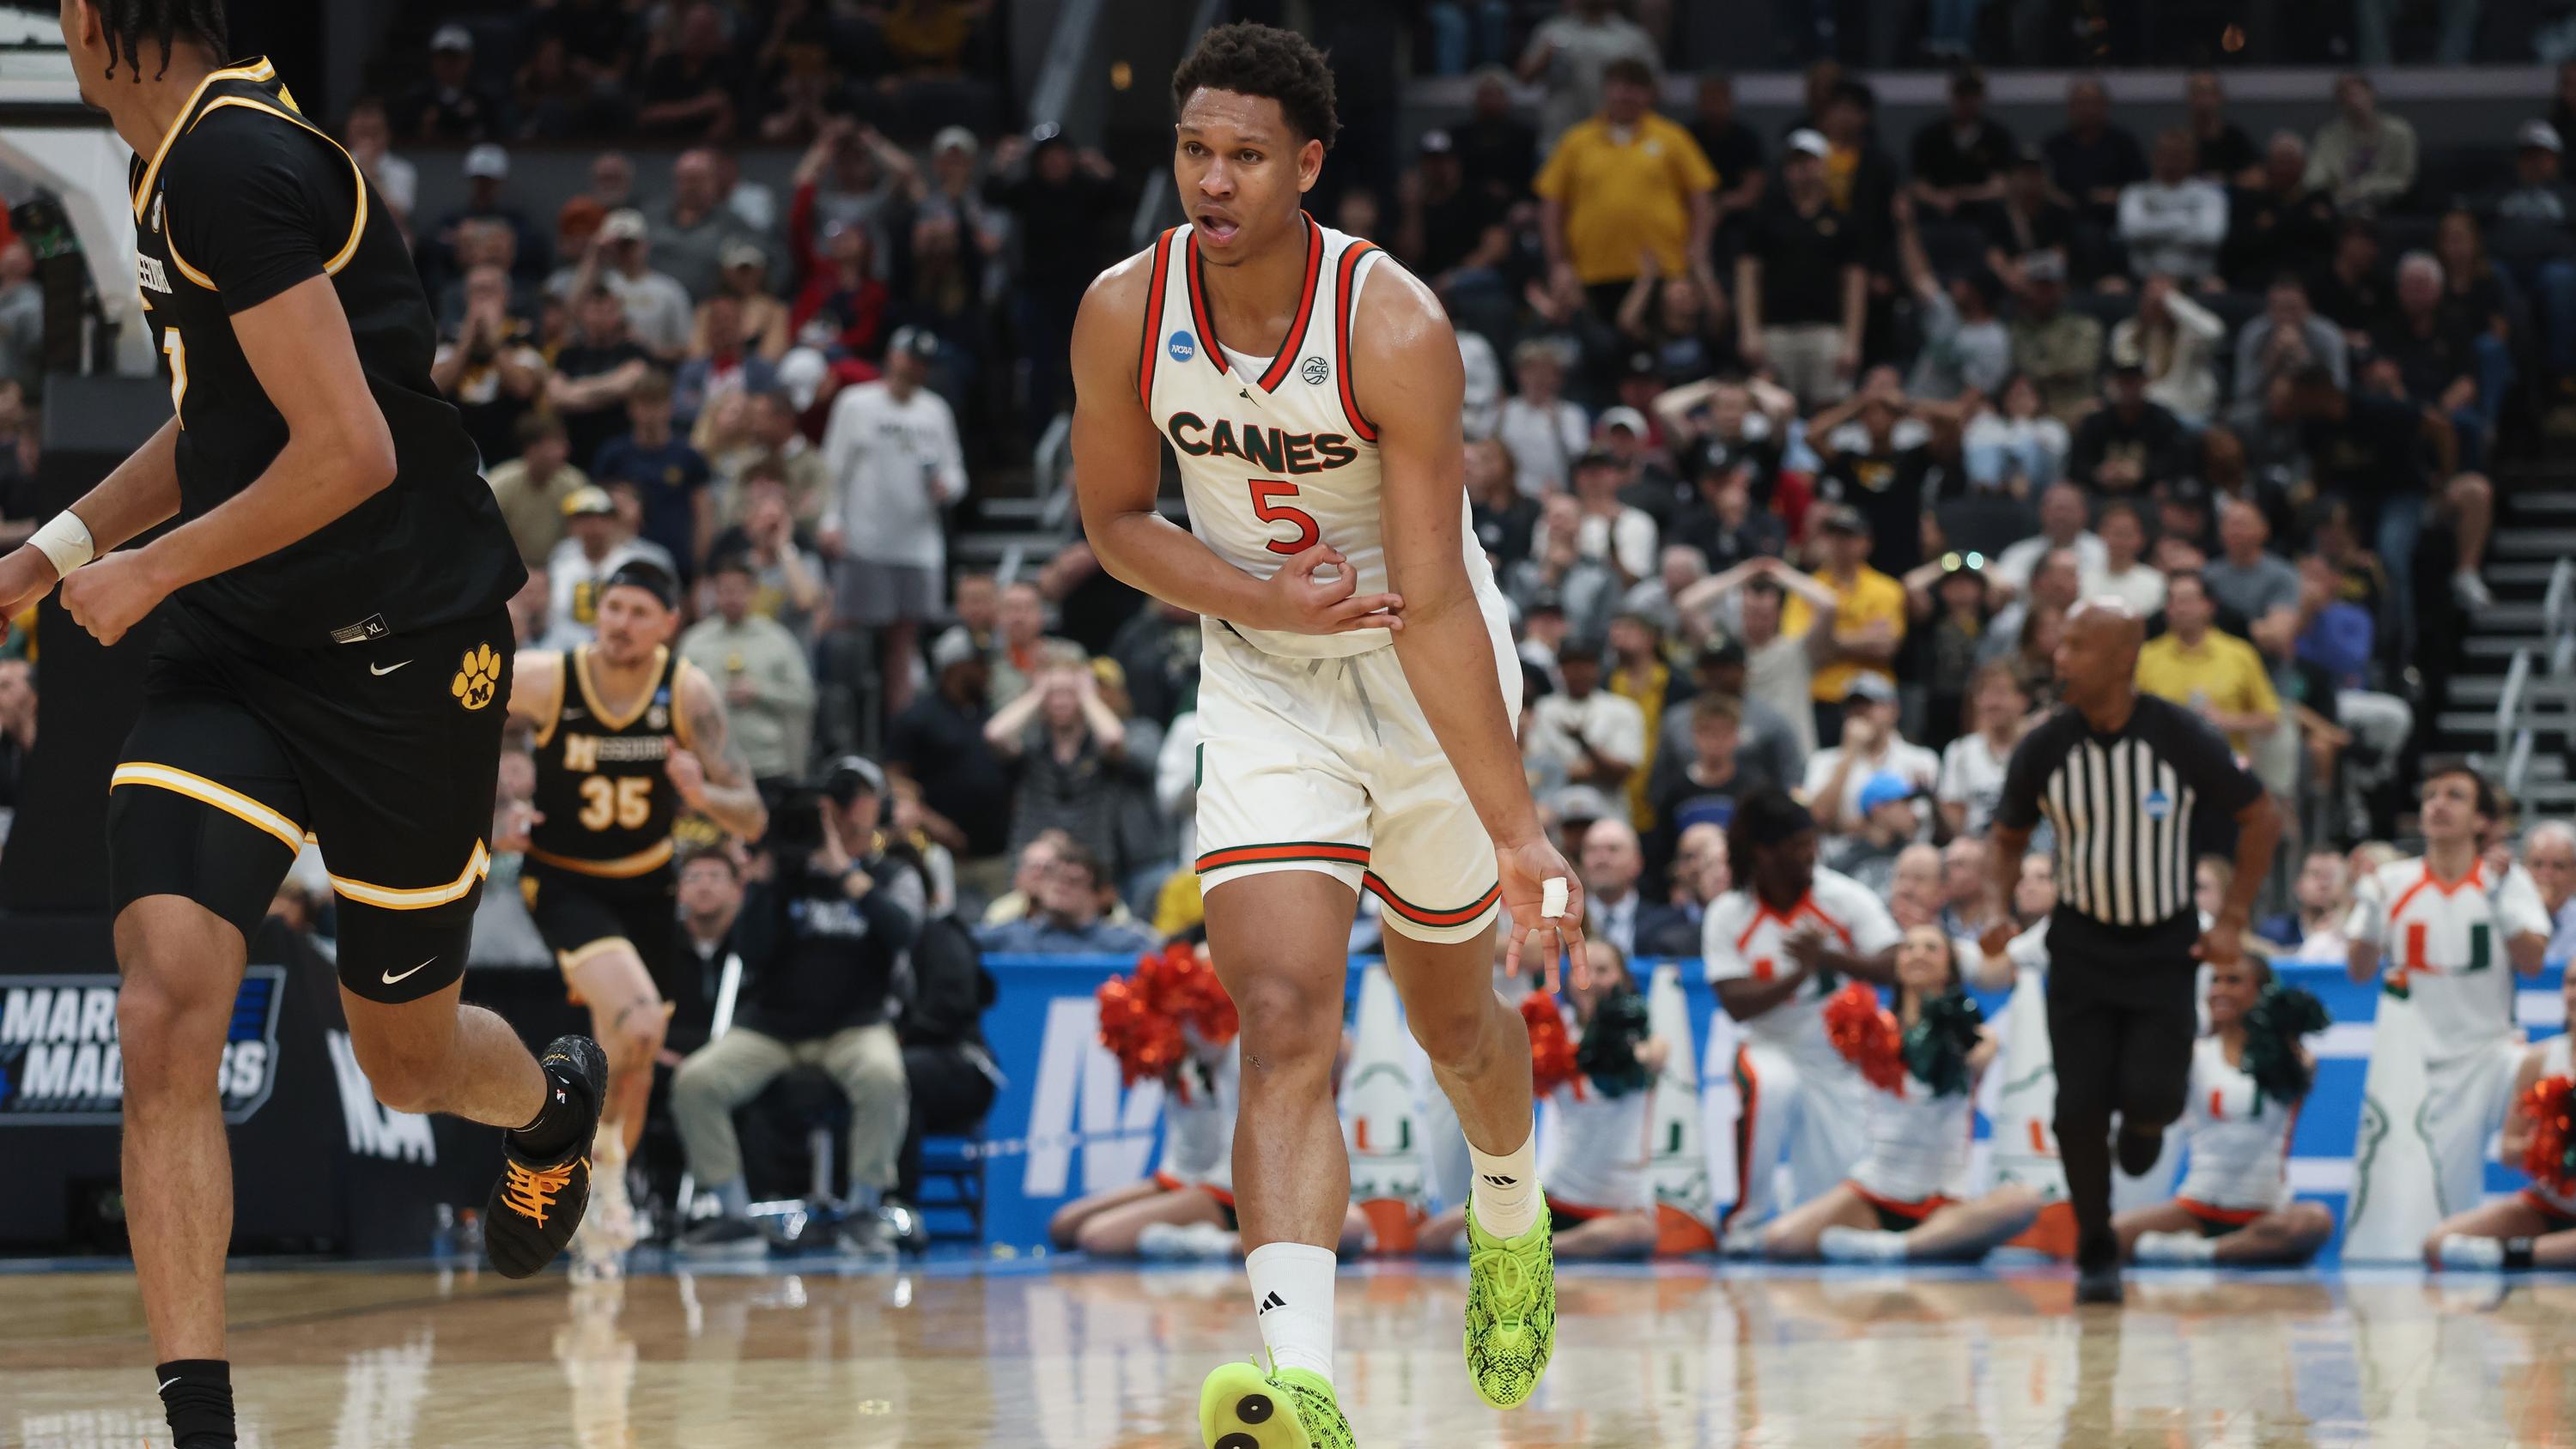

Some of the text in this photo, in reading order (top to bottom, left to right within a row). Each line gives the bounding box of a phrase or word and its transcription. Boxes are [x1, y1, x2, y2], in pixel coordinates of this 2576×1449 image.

[1171, 344, 1193, 355] NCAA
[1169, 412, 1358, 475] CANES
[1248, 479, 1320, 555] 5
[367, 623, 383, 635] XL
[470, 682, 489, 706] M
[562, 733, 667, 772] MISSOUR
[579, 775, 653, 831] 35
[2405, 922, 2490, 977] U
[0, 987, 120, 1044] MAR
[20, 1040, 267, 1099] MADS
[1355, 1117, 1411, 1157] U
